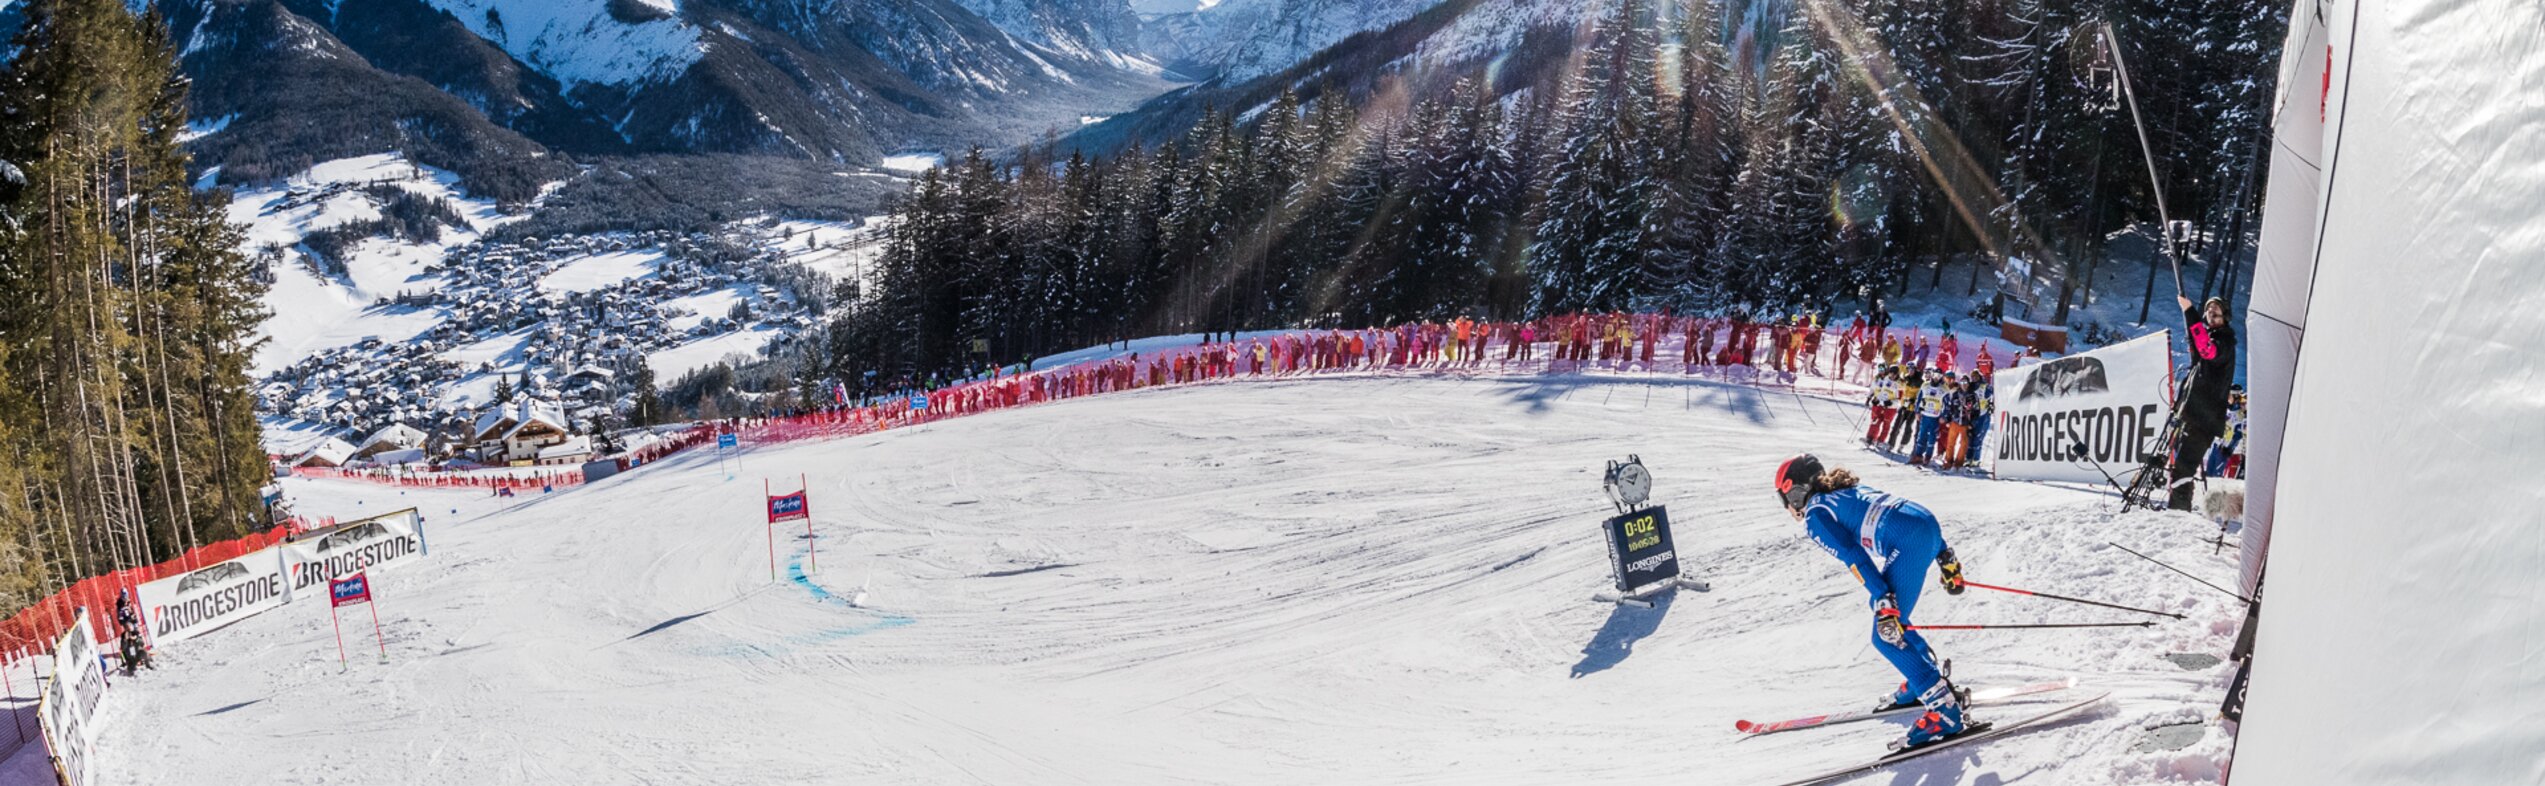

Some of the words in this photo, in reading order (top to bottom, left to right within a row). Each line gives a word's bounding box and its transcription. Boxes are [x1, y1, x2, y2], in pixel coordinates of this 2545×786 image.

[1999, 404, 2158, 463] BRIDGESTONE
[1625, 516, 1654, 536] 0:02
[292, 533, 417, 591] BRIDGESTONE
[1626, 550, 1673, 572] LONGINES
[154, 572, 281, 638] BRIDGESTONE
